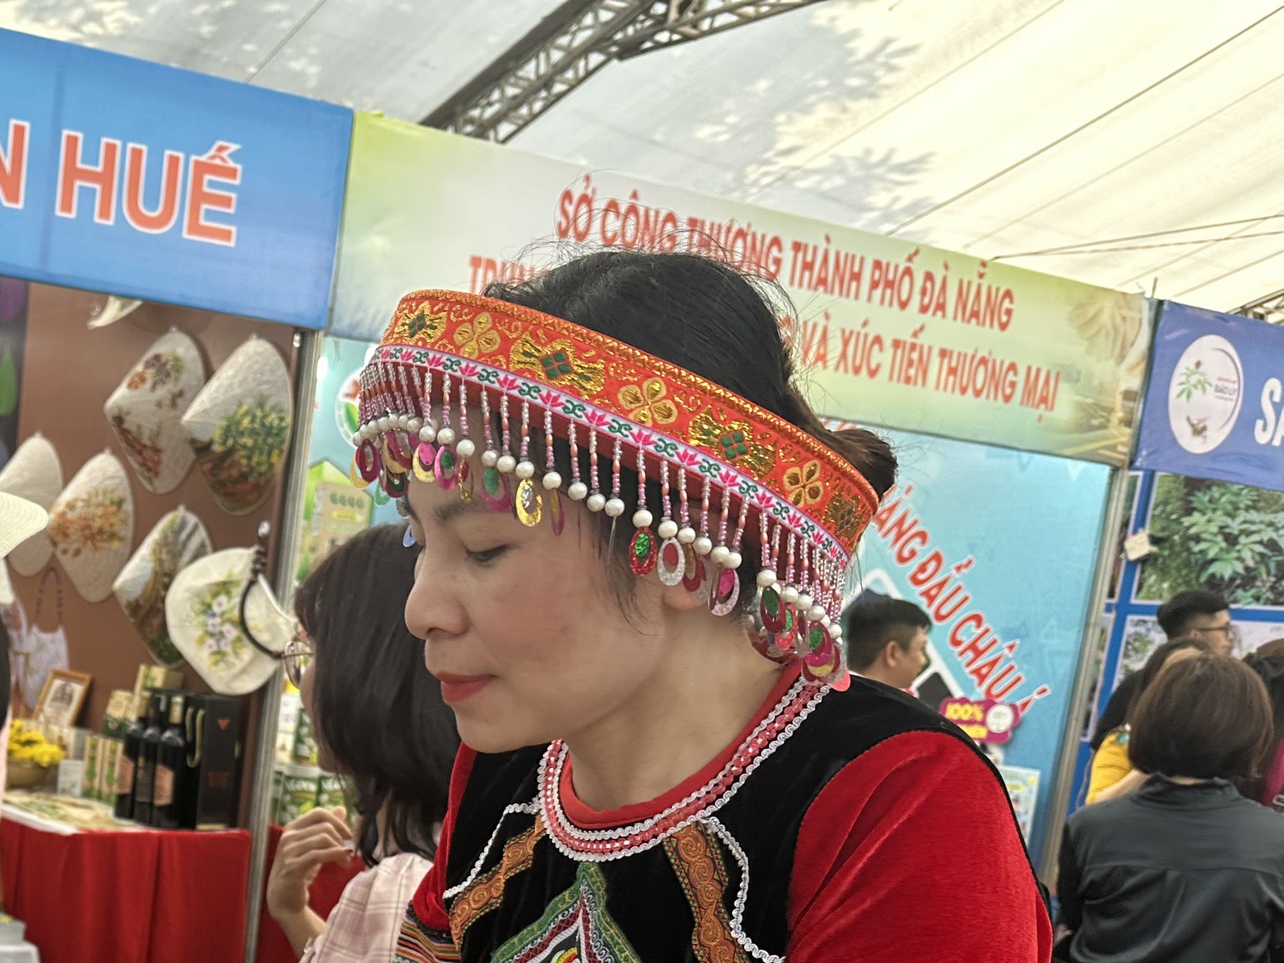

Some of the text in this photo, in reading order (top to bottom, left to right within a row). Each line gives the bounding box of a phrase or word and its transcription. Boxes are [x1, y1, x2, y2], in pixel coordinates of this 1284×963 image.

[56, 130, 243, 247] HUẾ
[600, 189, 678, 253] CÔNG
[788, 234, 864, 301] THÀNH
[867, 247, 919, 311] PHỐ
[918, 261, 950, 319] ĐÀ
[953, 261, 1015, 332] NẴNG
[801, 310, 830, 370] VÀ
[834, 318, 884, 379] XÚC
[888, 324, 933, 389] TIẾN
[935, 348, 1018, 404] THƯƠNG
[1020, 365, 1061, 423] MẠI
[948, 612, 1025, 701] CHÂU
